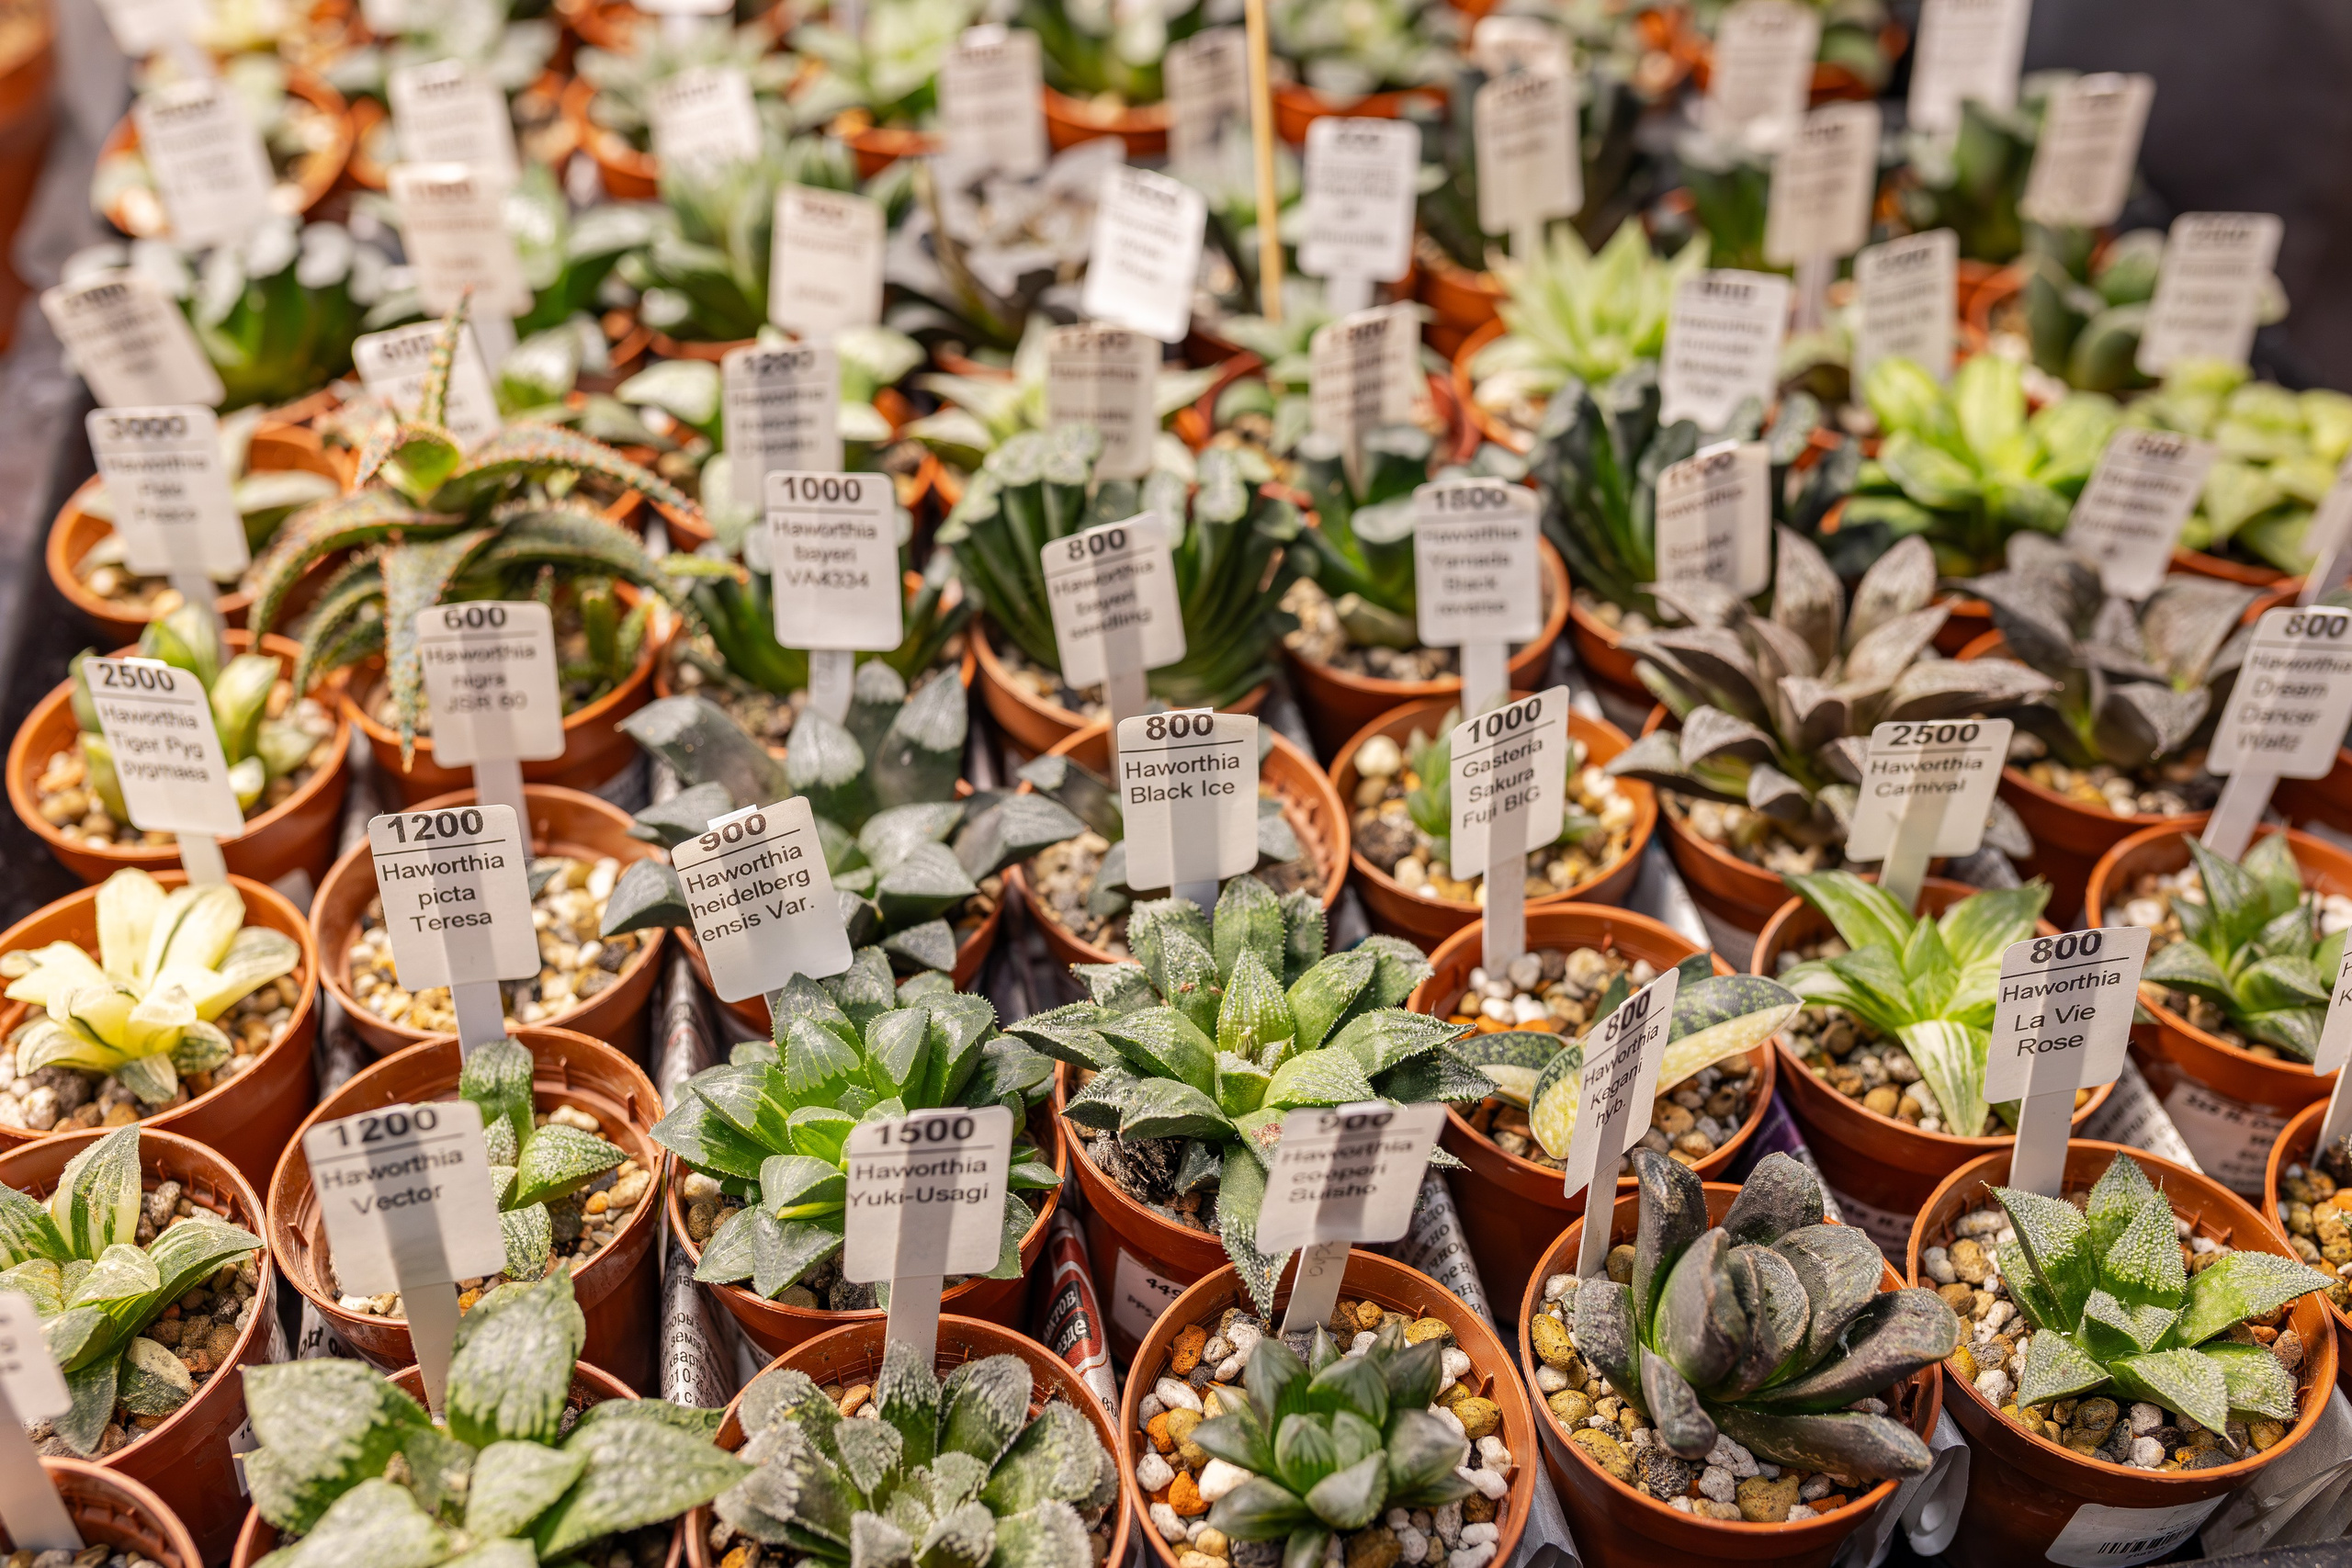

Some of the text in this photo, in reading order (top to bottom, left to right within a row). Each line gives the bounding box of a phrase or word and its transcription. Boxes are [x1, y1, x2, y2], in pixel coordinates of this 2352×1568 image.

[783, 478, 862, 502] 1000
[774, 518, 876, 539] Haworthia
[1068, 528, 1125, 561] 800
[1053, 559, 1154, 595] Haworthia
[445, 606, 505, 629] 600
[2285, 615, 2348, 638] 800
[426, 644, 537, 664] Haworthia
[98, 662, 175, 692] 2500
[101, 705, 198, 729] Haworthia
[1146, 714, 1214, 740] 800
[1467, 698, 1542, 744] 1000
[1889, 724, 1980, 747] 2500
[1125, 753, 1239, 779] Haworthia
[1463, 739, 1543, 778] Gasteria
[1871, 756, 1983, 774] Haworthia
[1130, 780, 1235, 805] Black Ice
[1469, 768, 1534, 803] Sakura
[1874, 779, 1967, 798] Carnival
[1463, 785, 1541, 829] Fuji BIG
[387, 808, 484, 843] 1200
[698, 814, 767, 852] 900
[381, 852, 505, 882] Haworthia
[686, 845, 803, 894] Haworthia
[418, 886, 476, 910] picta
[690, 869, 810, 919] heidelberg
[410, 911, 493, 932] Teresa
[702, 897, 815, 942] ensis Var.
[2030, 931, 2103, 964] 800
[2003, 970, 2121, 1003] Haworthia
[1604, 989, 1652, 1043] 800
[2014, 1004, 2097, 1032] La Vie
[1583, 1024, 1659, 1091] Haworthia
[2017, 1034, 2084, 1057] Rose
[1589, 1057, 1644, 1111] Kegani
[329, 1109, 437, 1147] 1200
[1319, 1112, 1394, 1134] 900
[1595, 1099, 1626, 1129] hyb.
[874, 1116, 975, 1145] 1500
[1282, 1140, 1413, 1163] Haworthia
[322, 1149, 463, 1190] Haworthia
[856, 1156, 987, 1181] Haworthia
[350, 1183, 445, 1215] Vector
[850, 1182, 989, 1207] Yuki-Usagi
